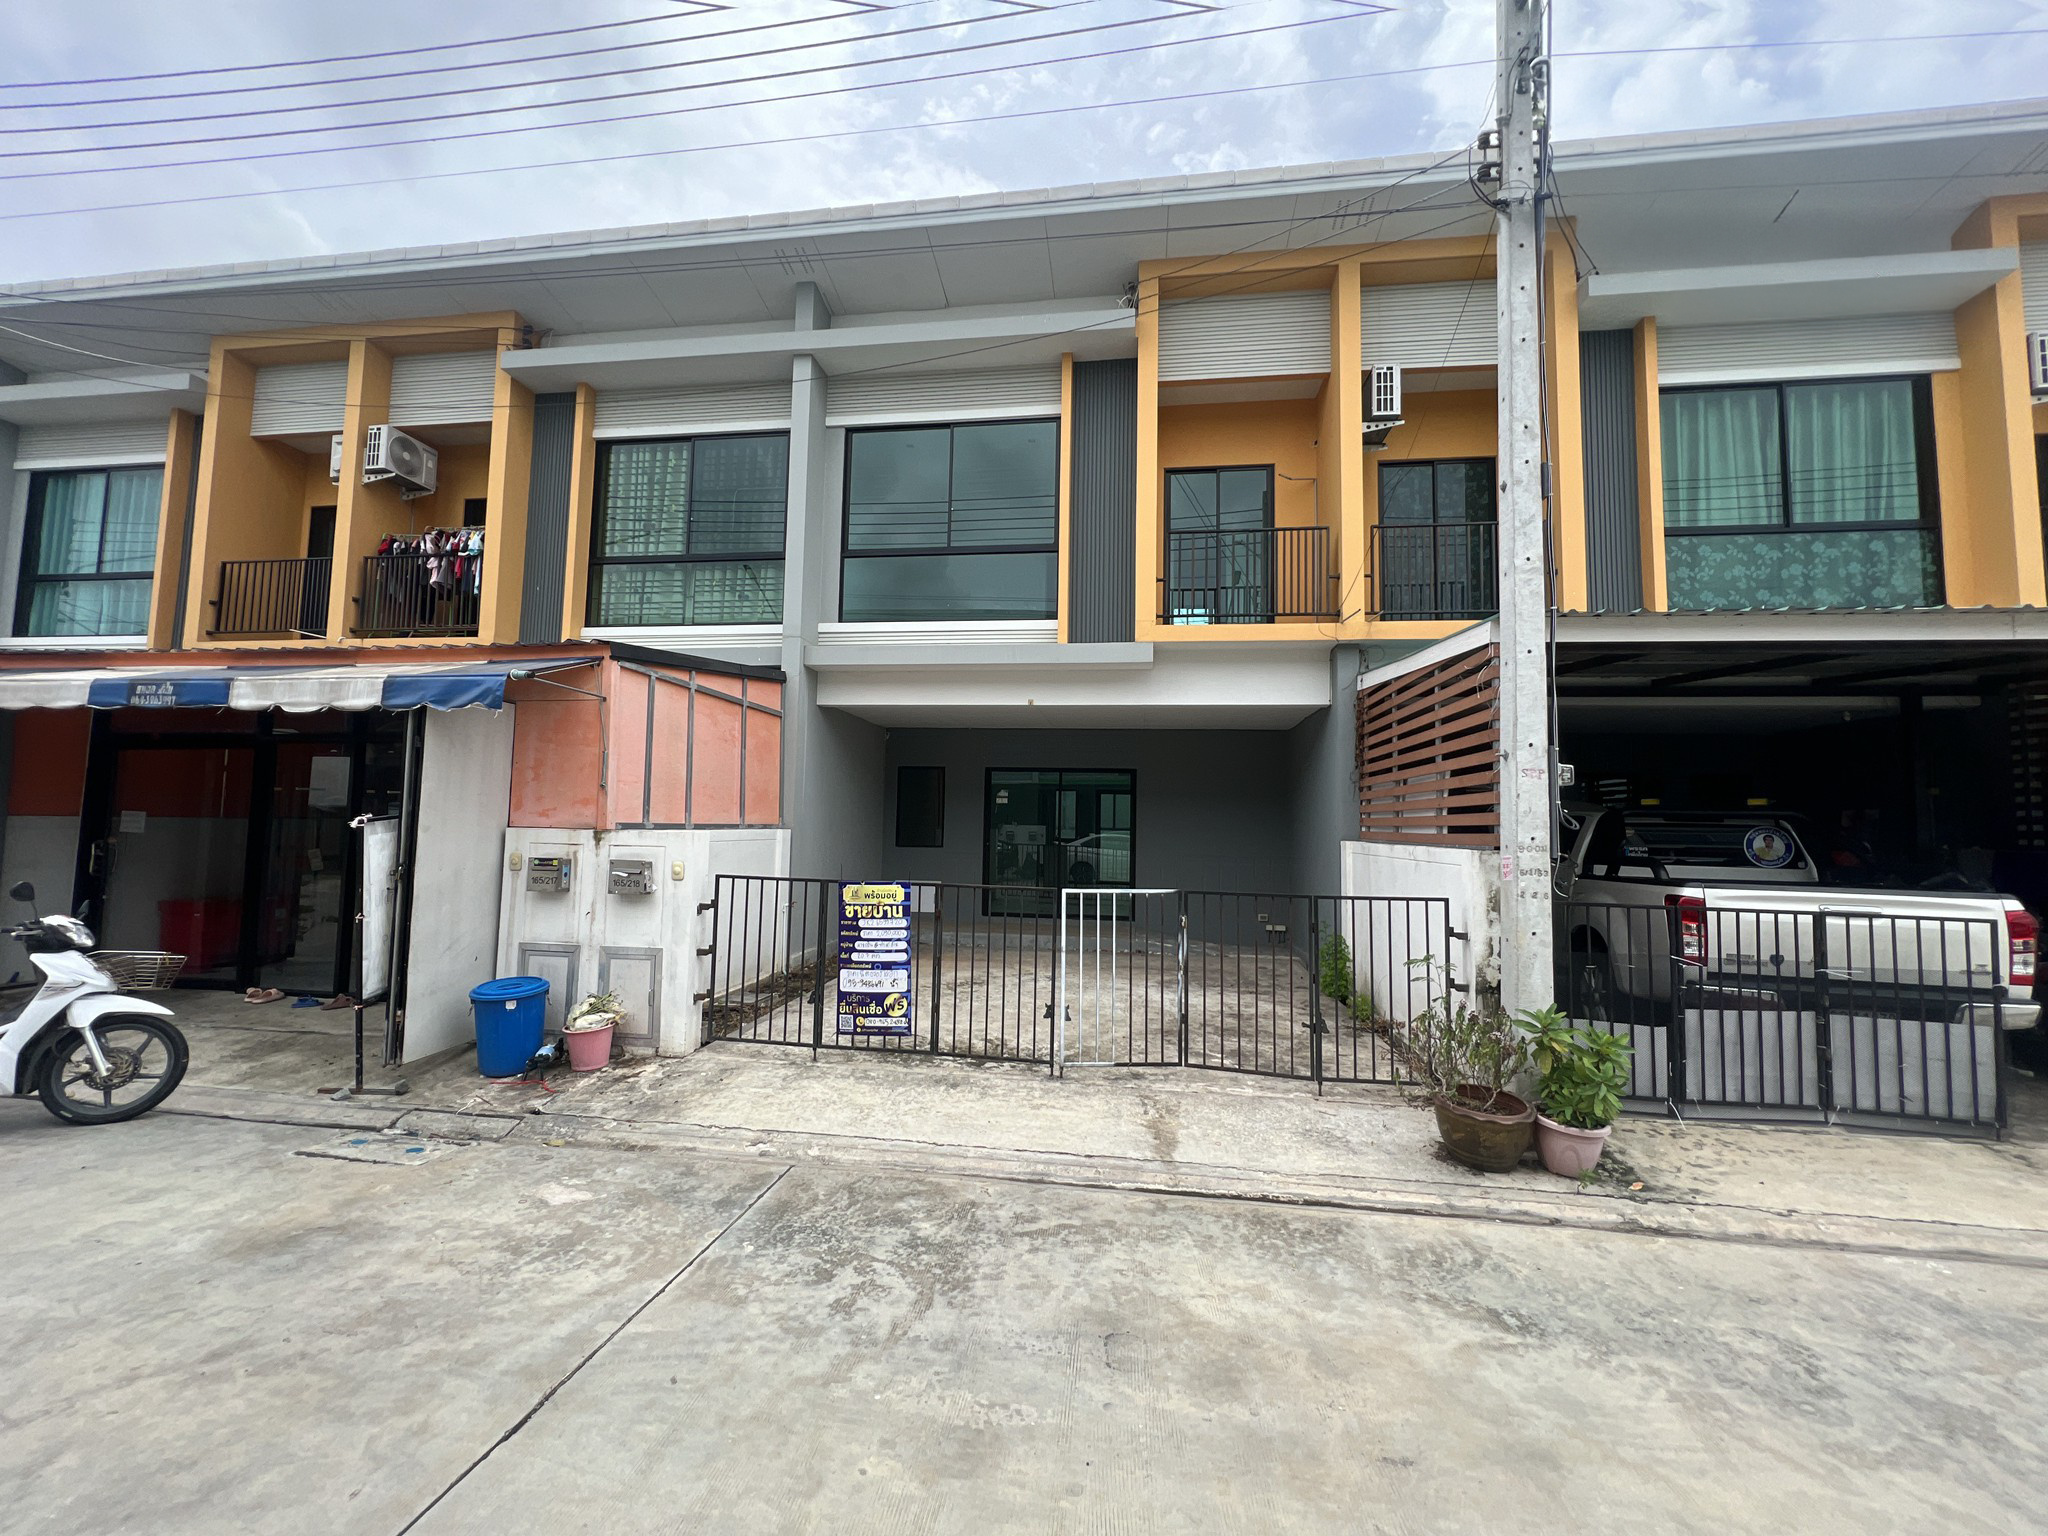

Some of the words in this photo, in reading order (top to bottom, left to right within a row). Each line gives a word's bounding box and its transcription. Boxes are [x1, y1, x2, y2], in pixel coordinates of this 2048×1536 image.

[531, 876, 558, 885] 165/217
[613, 879, 640, 888] 165/218
[864, 890, 897, 902] พร้อมอยู่
[845, 901, 903, 918] ขายบ้าน
[847, 993, 870, 1002] บริการ
[840, 1000, 883, 1014] ยื่นสินเชื่อ
